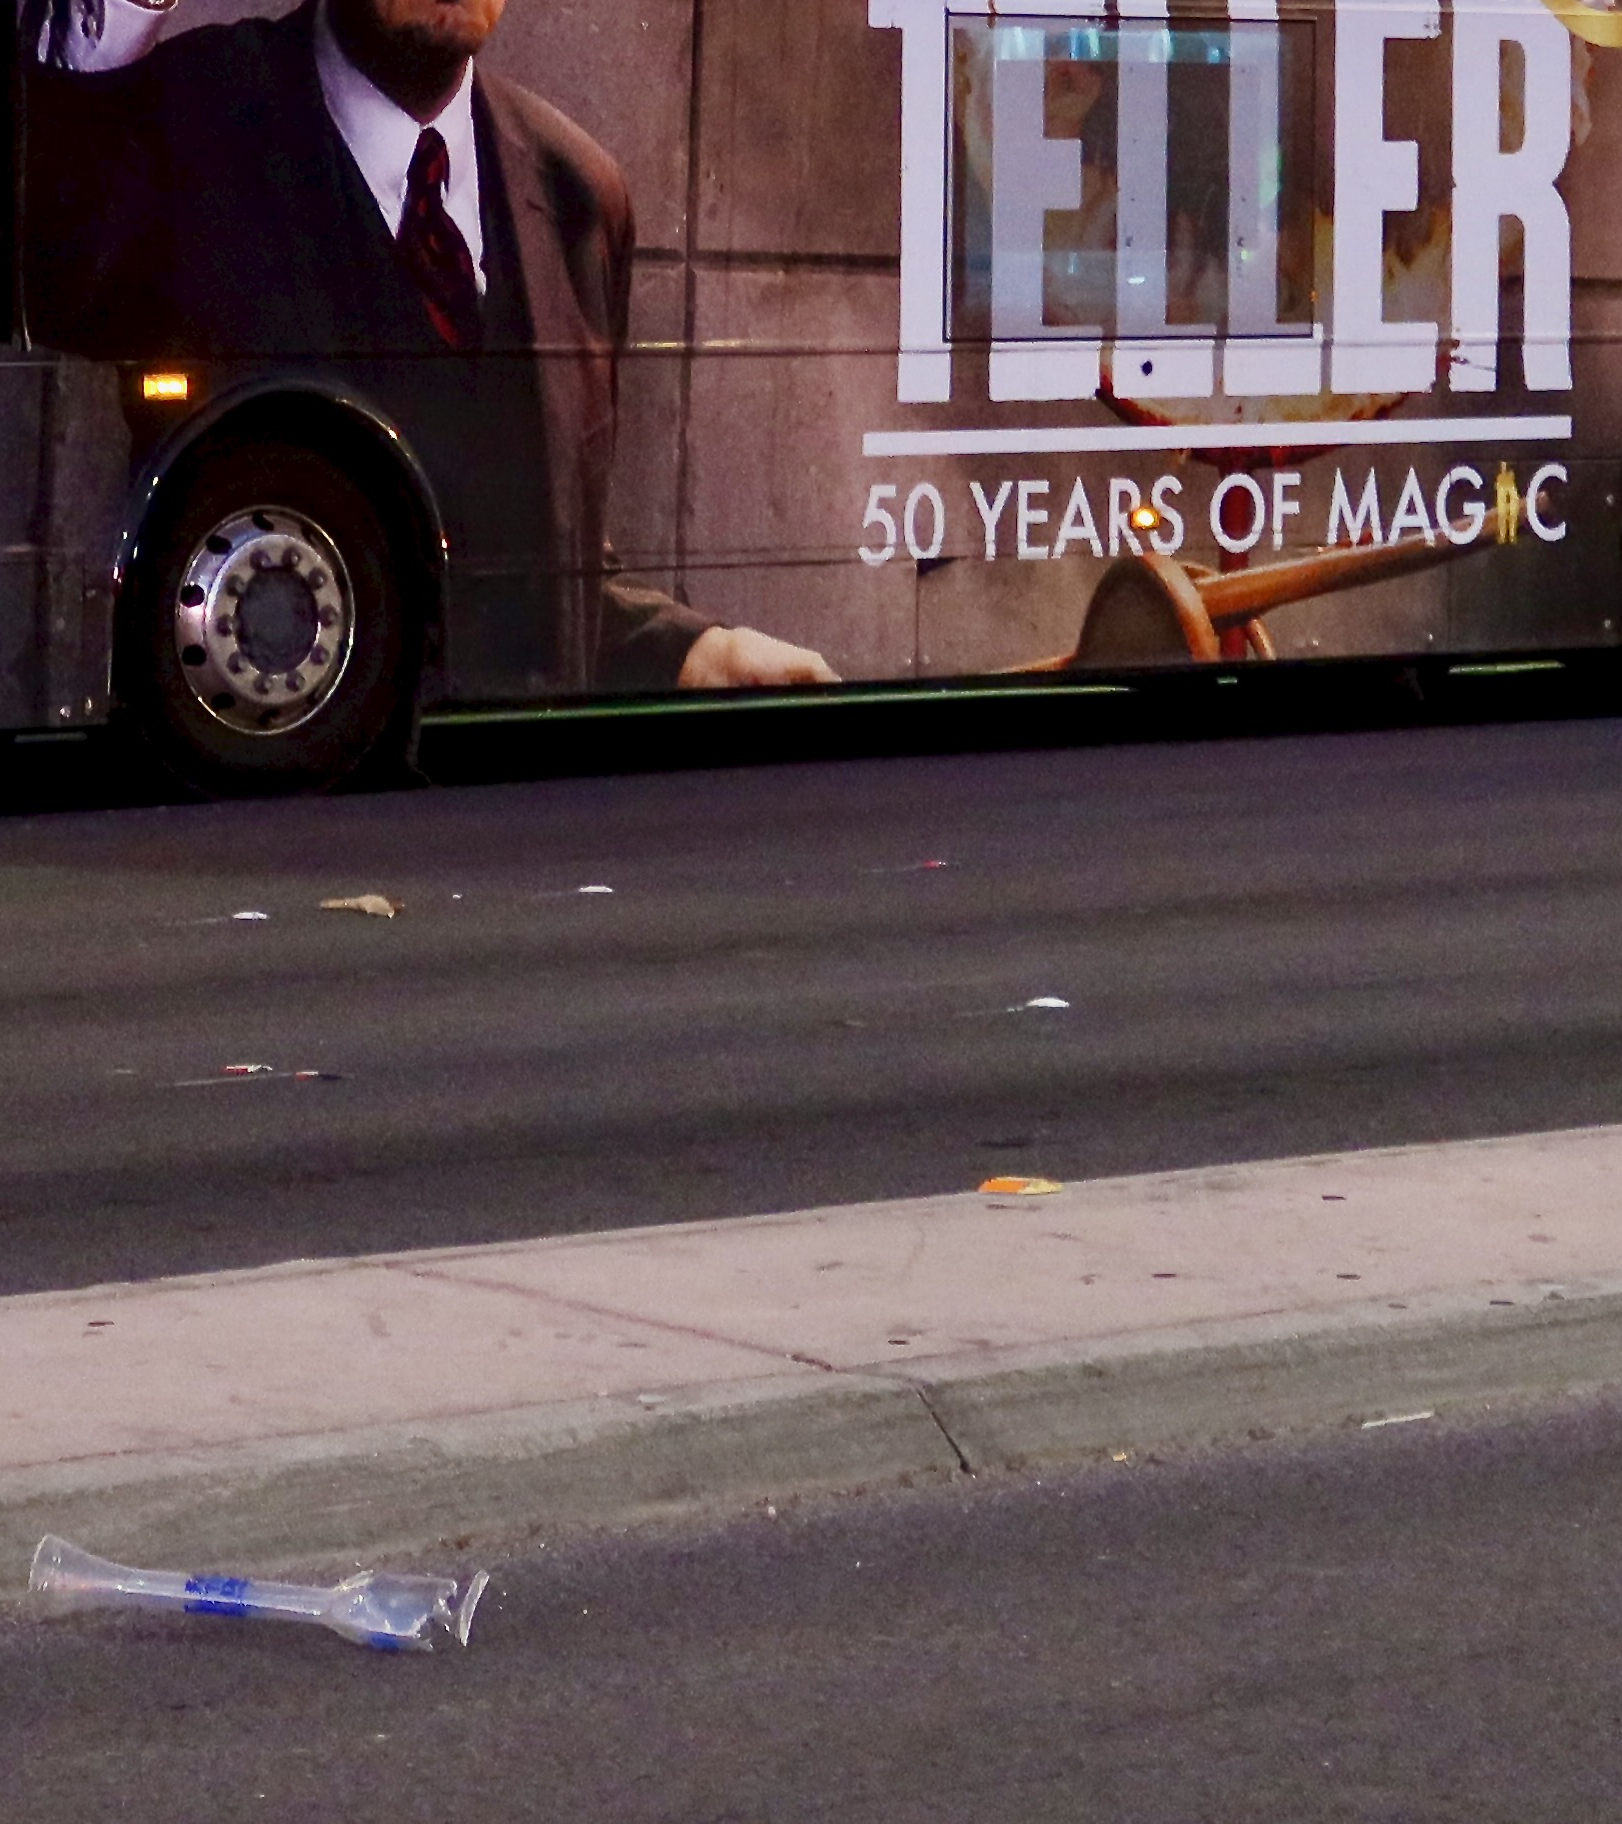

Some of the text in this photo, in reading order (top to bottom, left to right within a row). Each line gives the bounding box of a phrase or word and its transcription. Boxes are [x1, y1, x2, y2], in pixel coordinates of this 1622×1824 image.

[857, 460, 1568, 566] 50 YEARS OF MAGIC
